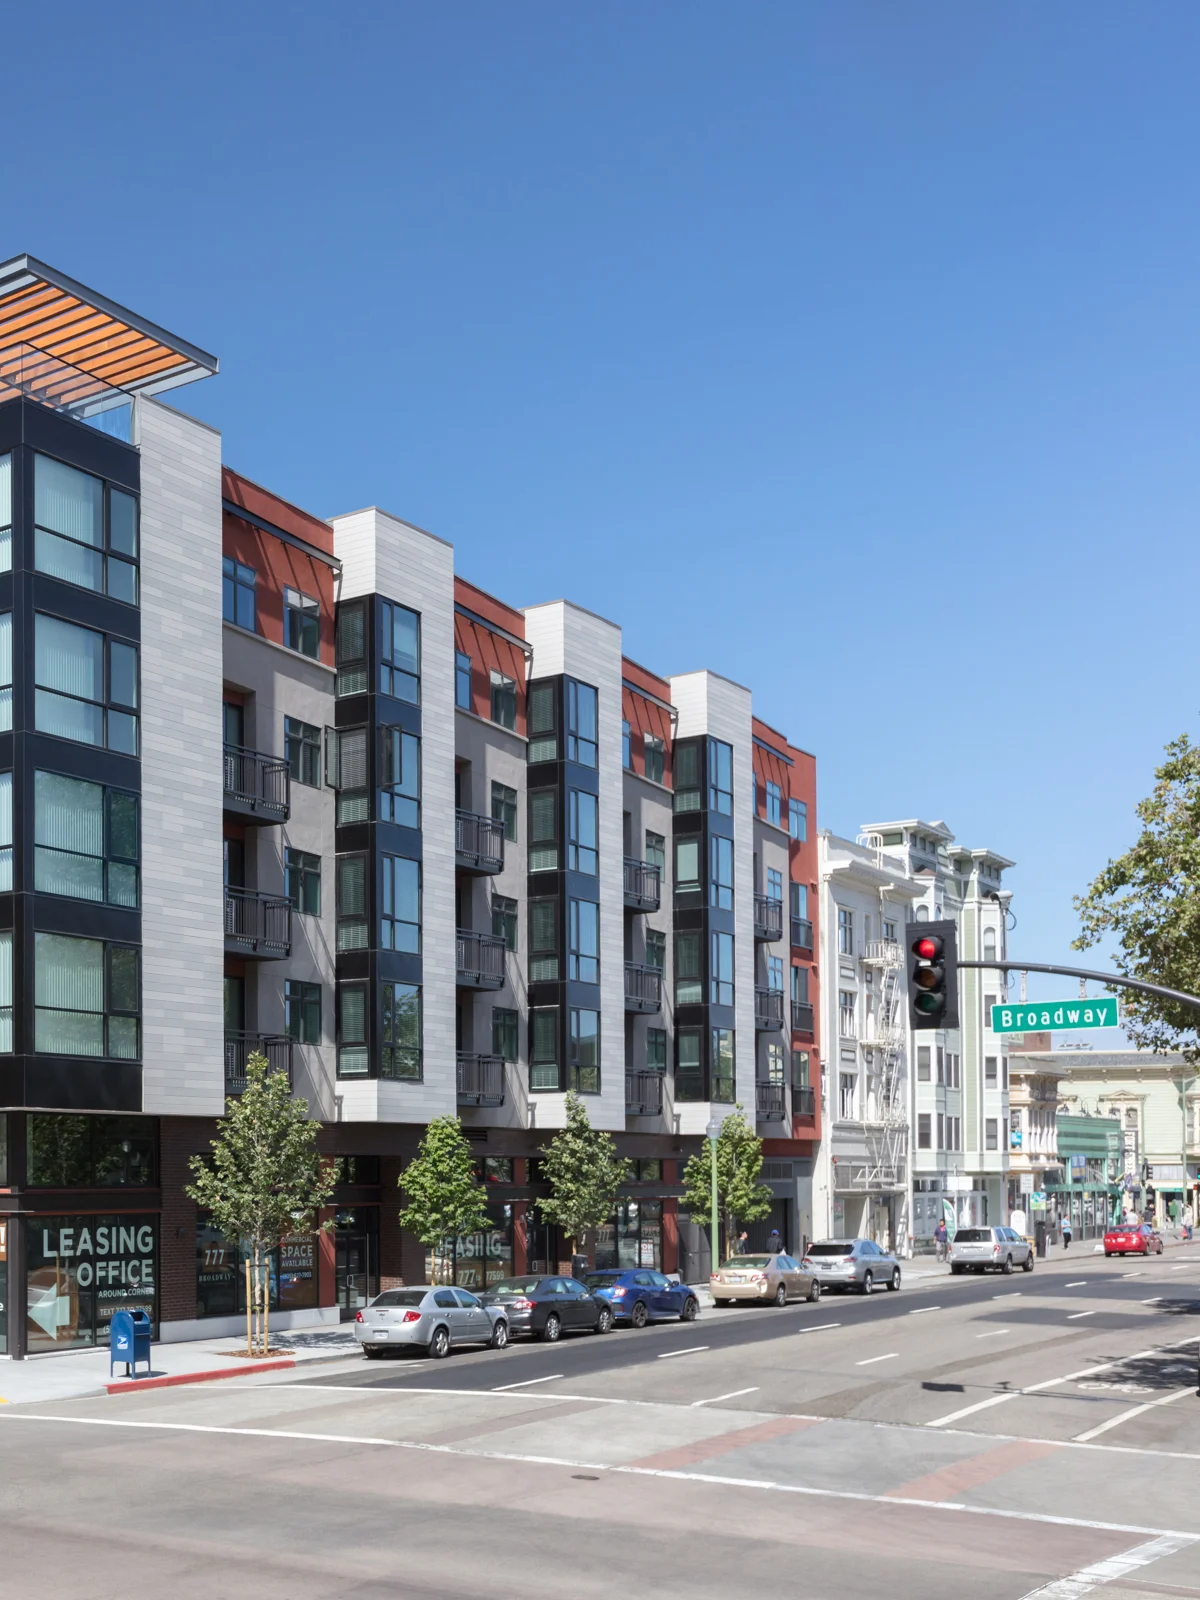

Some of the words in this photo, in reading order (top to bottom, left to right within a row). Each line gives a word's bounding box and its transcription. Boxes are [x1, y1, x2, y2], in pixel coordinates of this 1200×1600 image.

[1001, 1007, 1107, 1027] Broadway
[43, 1225, 153, 1258] LEASING
[205, 1248, 225, 1266] 777
[281, 1244, 313, 1258] SPACE
[281, 1259, 313, 1268] AVAILABLE
[77, 1259, 154, 1287] OFFICE
[458, 1269, 475, 1285] 777
[98, 1289, 127, 1298] AROUND
[128, 1287, 154, 1296] CORNER
[100, 1307, 115, 1316] TEXT
